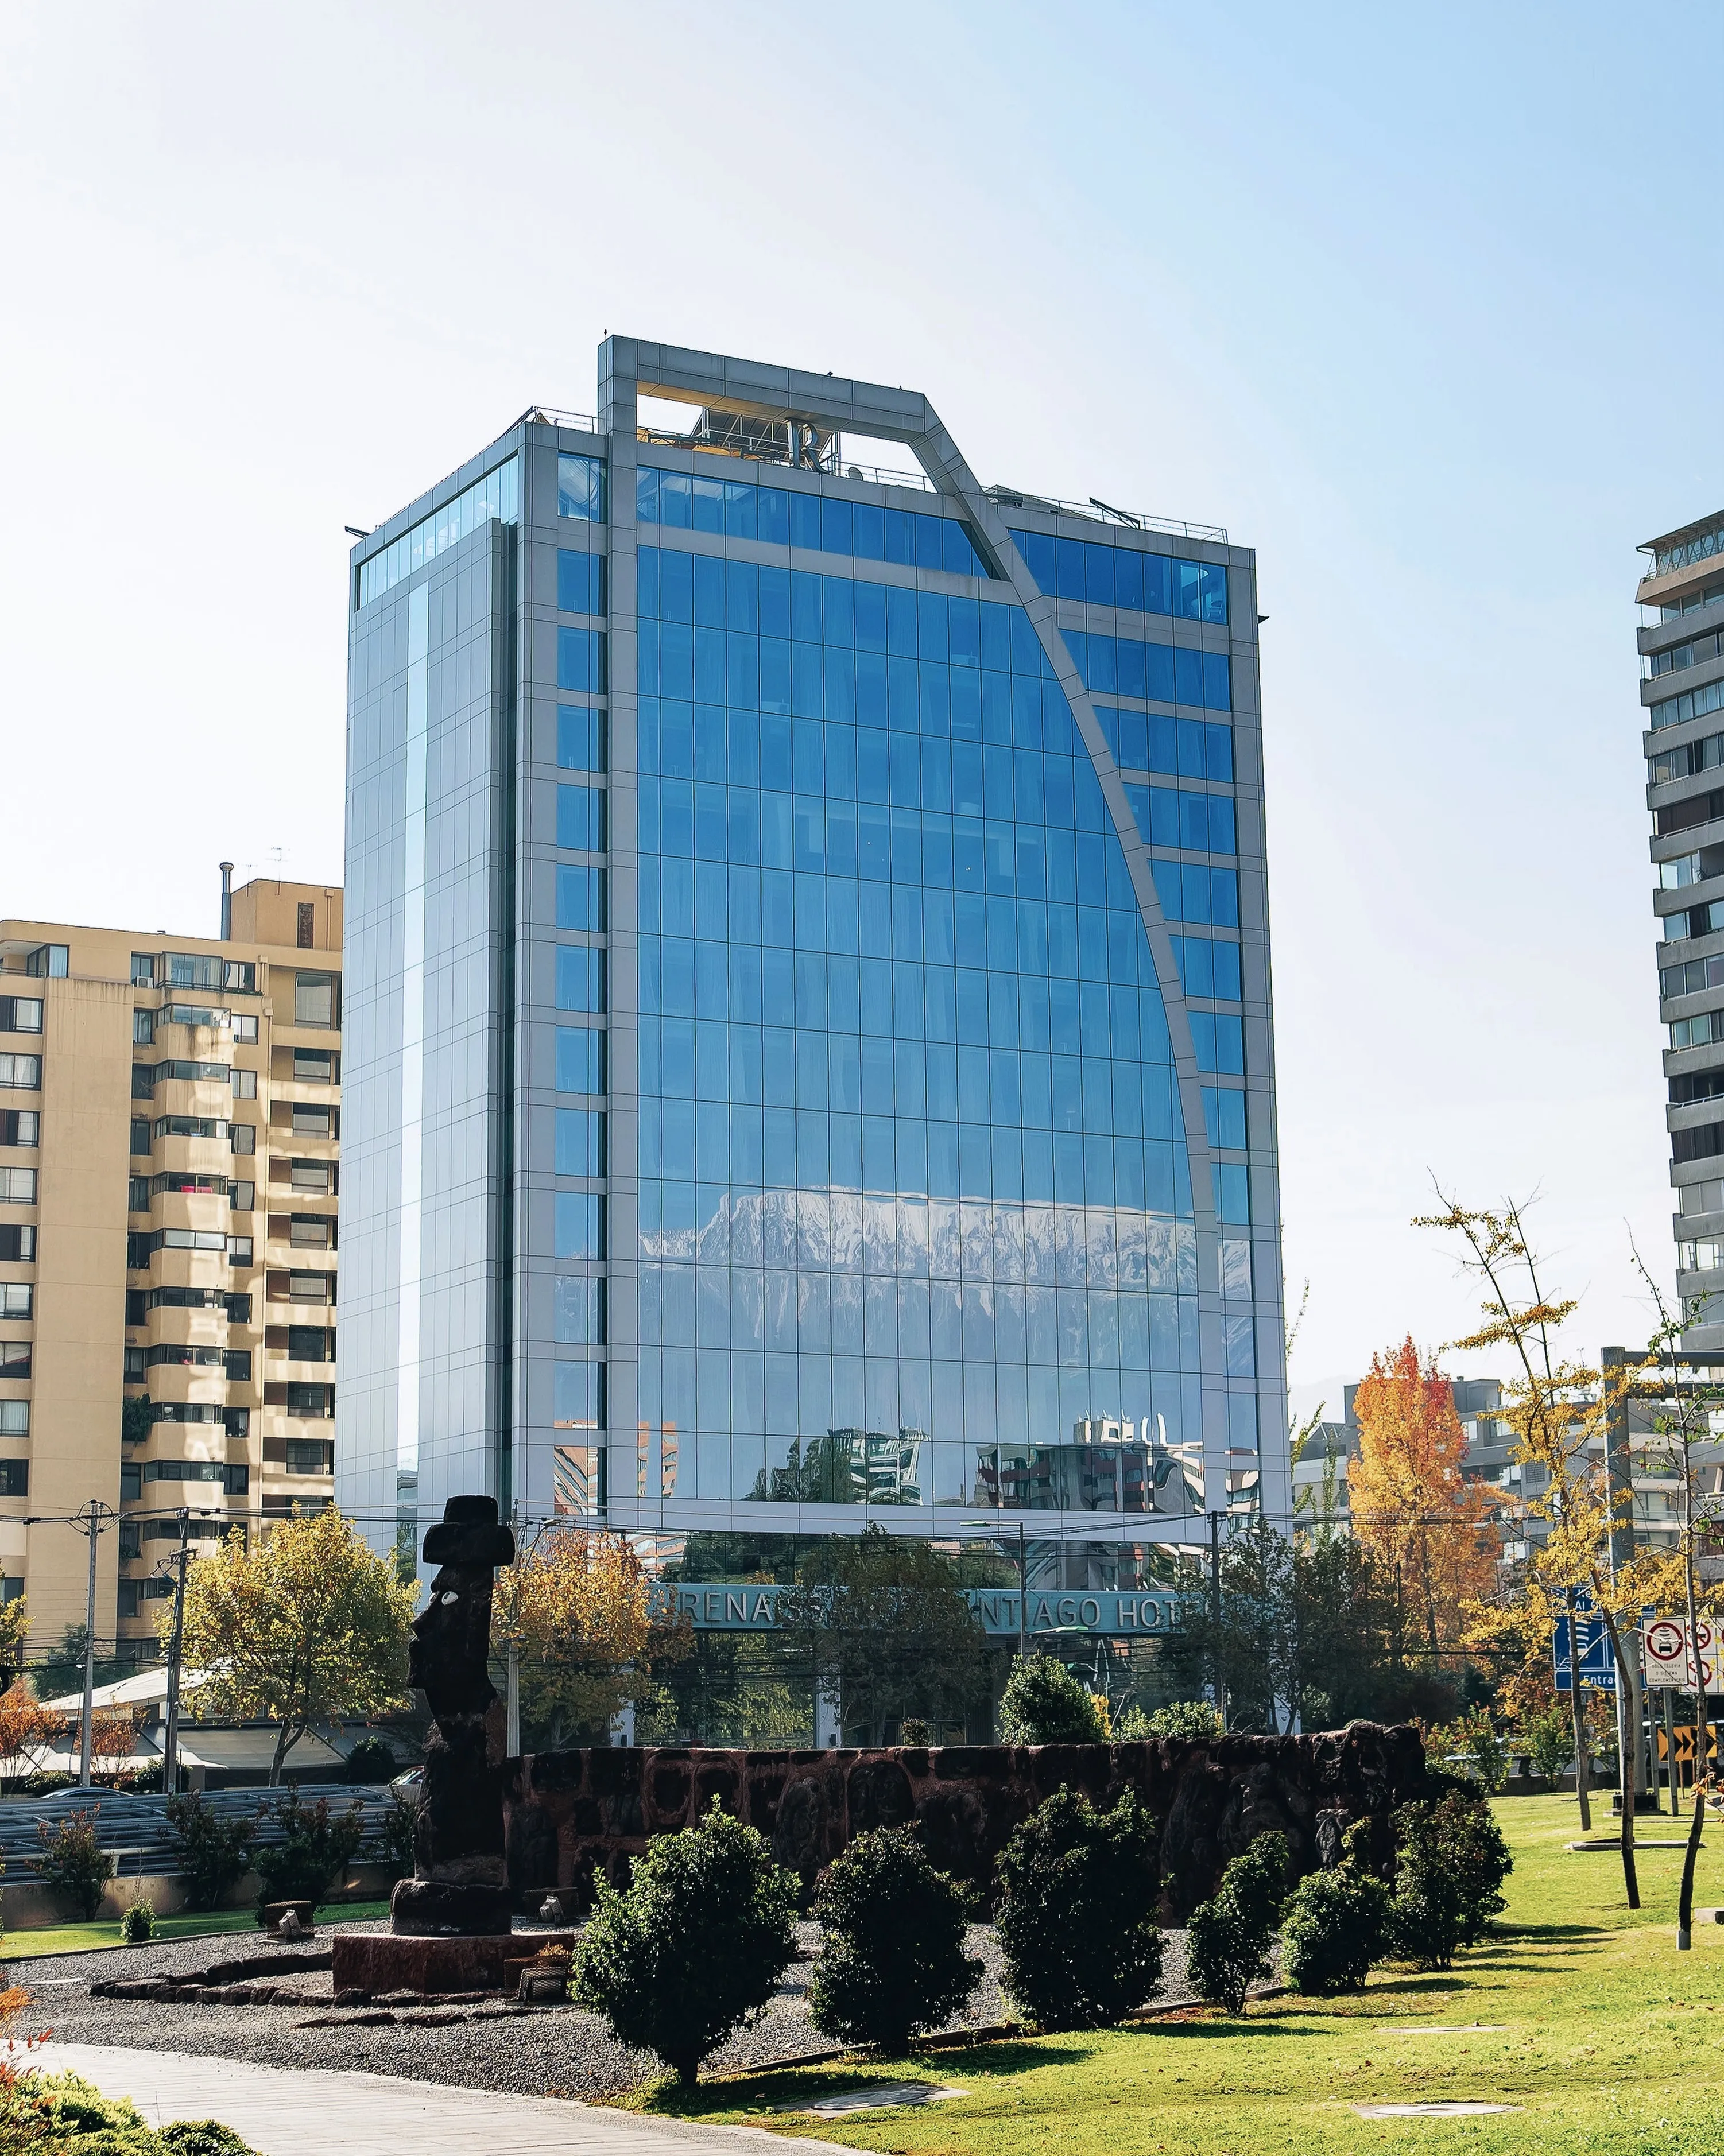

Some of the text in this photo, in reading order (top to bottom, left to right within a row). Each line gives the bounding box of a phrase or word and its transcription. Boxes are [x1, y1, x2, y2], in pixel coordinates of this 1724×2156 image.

[782, 417, 832, 473] R
[978, 1596, 1101, 1627] NTIAGO
[1583, 1674, 1617, 1684] Entra
